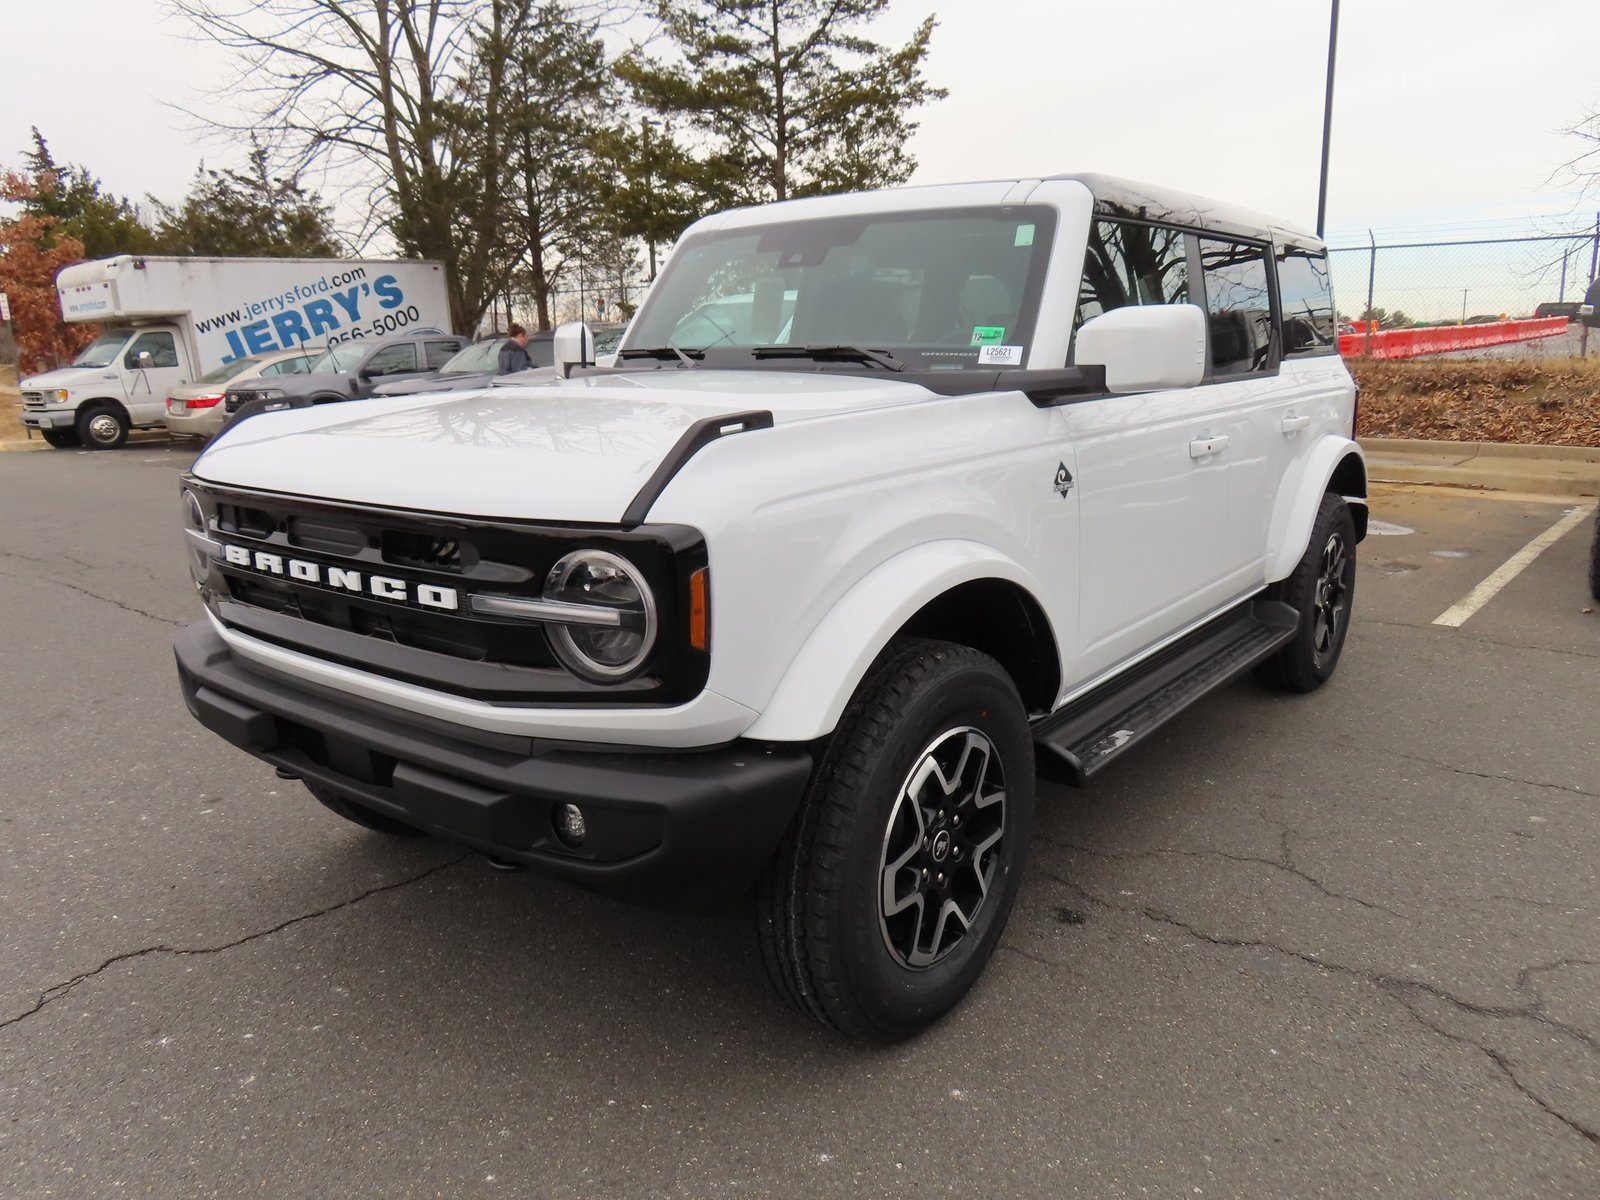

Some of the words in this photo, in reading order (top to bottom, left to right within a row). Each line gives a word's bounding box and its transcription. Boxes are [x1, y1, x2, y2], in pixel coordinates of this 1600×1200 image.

[195, 267, 366, 334] www.jerrysford.com
[221, 275, 404, 364] JERRY'S
[986, 348, 1012, 356] L25621
[225, 544, 458, 610] BRONCO
